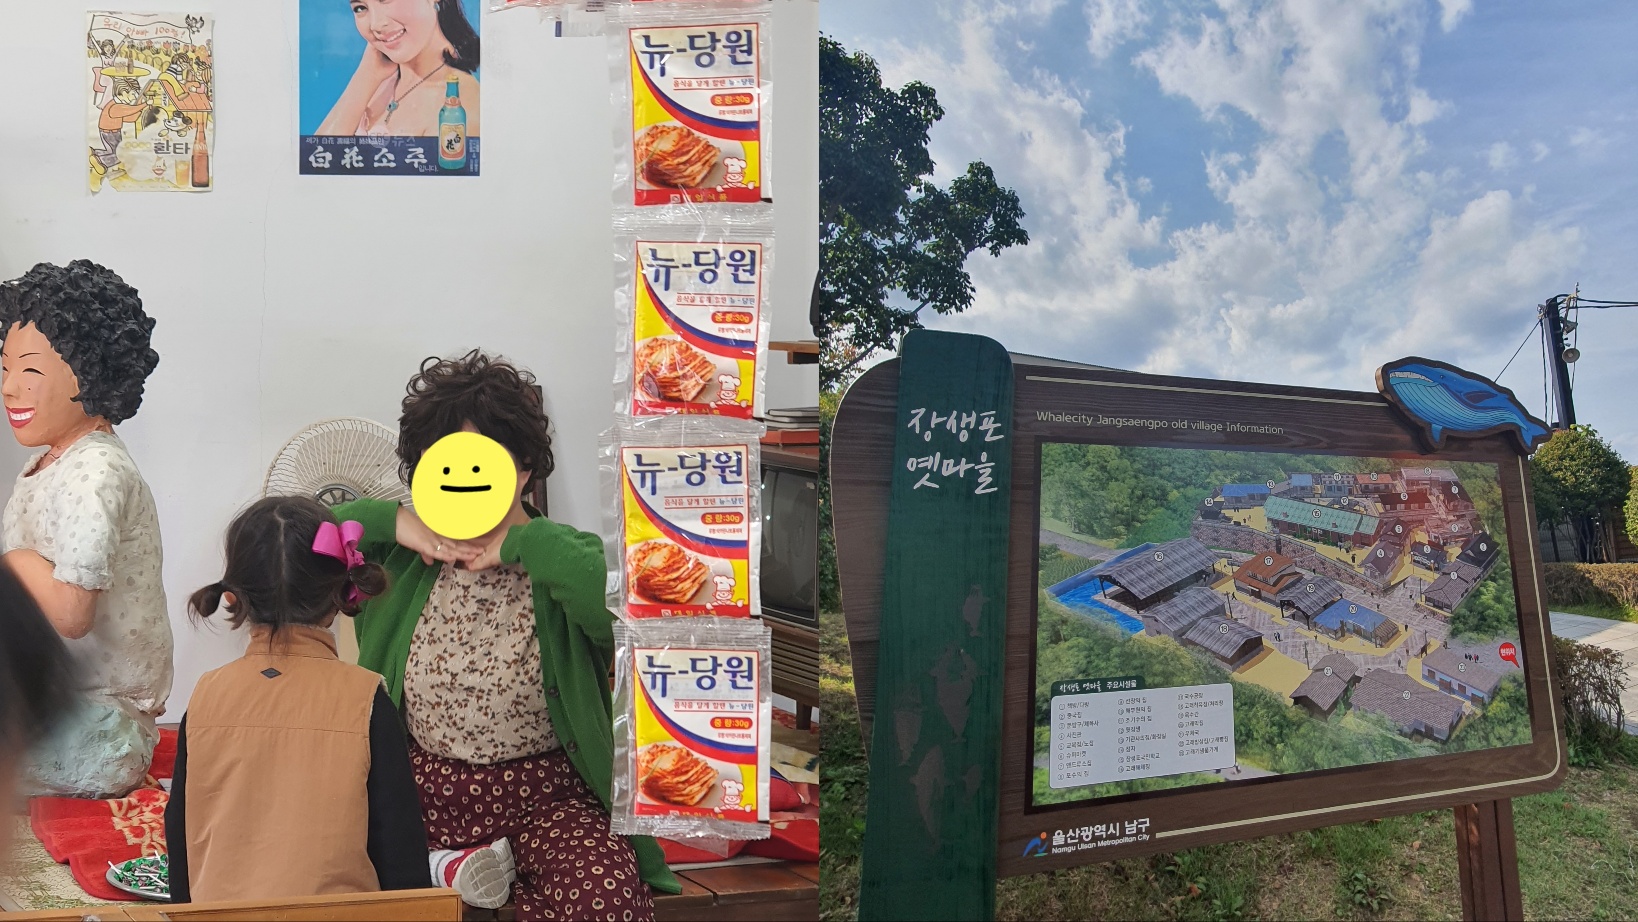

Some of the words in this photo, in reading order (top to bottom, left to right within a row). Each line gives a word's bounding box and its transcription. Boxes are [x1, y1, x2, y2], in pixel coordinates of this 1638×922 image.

[640, 29, 753, 77] 뉴-당원
[153, 140, 191, 154] 환타
[646, 248, 757, 291] 뉴-당원
[908, 408, 1004, 442] 장생포
[1036, 410, 1093, 426] Whalecity
[1097, 414, 1168, 430] Jangsaengpo
[1171, 418, 1188, 429] old
[1190, 420, 1223, 433] village
[1226, 421, 1284, 435] Information
[631, 451, 743, 496] 뉴-당원
[907, 452, 998, 494] 옛마을
[642, 655, 754, 697] 뉴-당원
[1052, 822, 1120, 846] 울산광역시
[1124, 818, 1150, 835] 남구
[1052, 844, 1076, 854] Namgu
[1077, 842, 1096, 850] Ulsan
[1097, 836, 1136, 847] Metropolitan
